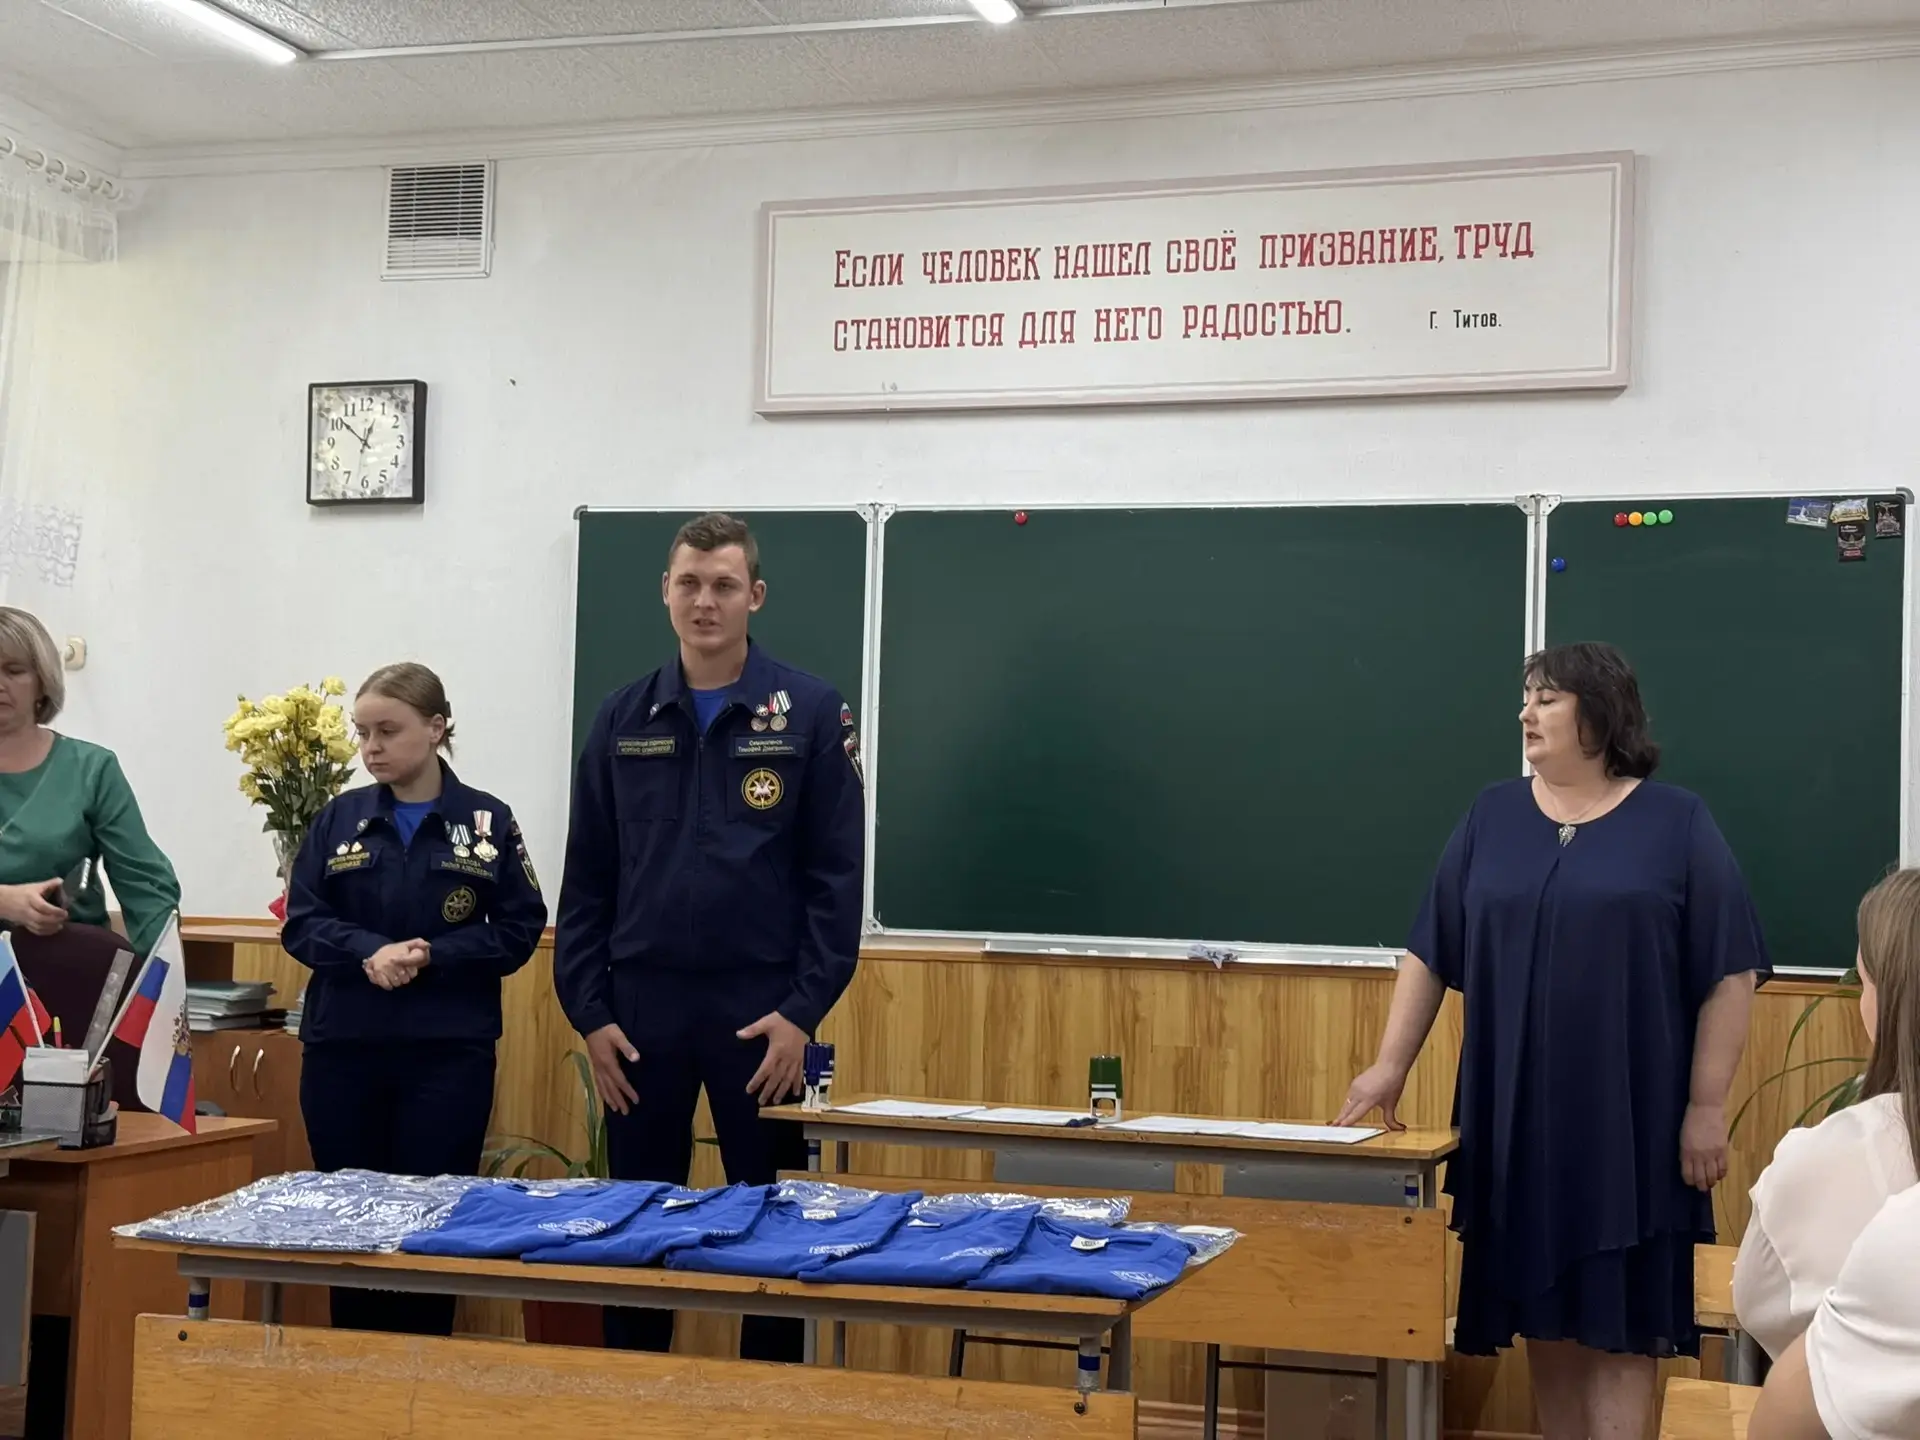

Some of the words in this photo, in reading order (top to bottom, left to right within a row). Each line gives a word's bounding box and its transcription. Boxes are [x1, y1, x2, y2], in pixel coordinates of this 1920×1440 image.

[922, 247, 1041, 284] ЧЕЛОВЕК
[1054, 242, 1151, 279] НАШЕЛ
[1166, 230, 1236, 274] СВОЁ
[1259, 226, 1444, 269] ПРИЗВАНИЕ,
[1454, 221, 1534, 260] ТРУД
[834, 313, 1005, 352] СТАНОВИТСЯ
[1018, 309, 1076, 349] ДЛЯ
[1094, 306, 1162, 342] НЕГО
[1183, 300, 1351, 341] РАДОСТЬЮ.
[1429, 310, 1439, 330] Г.
[344, 402, 356, 417] 11
[359, 397, 374, 412] 12
[381, 402, 386, 415] 1
[330, 417, 343, 431] 10
[391, 415, 399, 429] 2
[327, 437, 335, 450] 9
[396, 434, 405, 449] 3
[331, 456, 340, 471] 8
[390, 455, 399, 468] 4
[343, 470, 351, 484] 7
[361, 475, 369, 489] 6
[379, 469, 387, 483] 5
